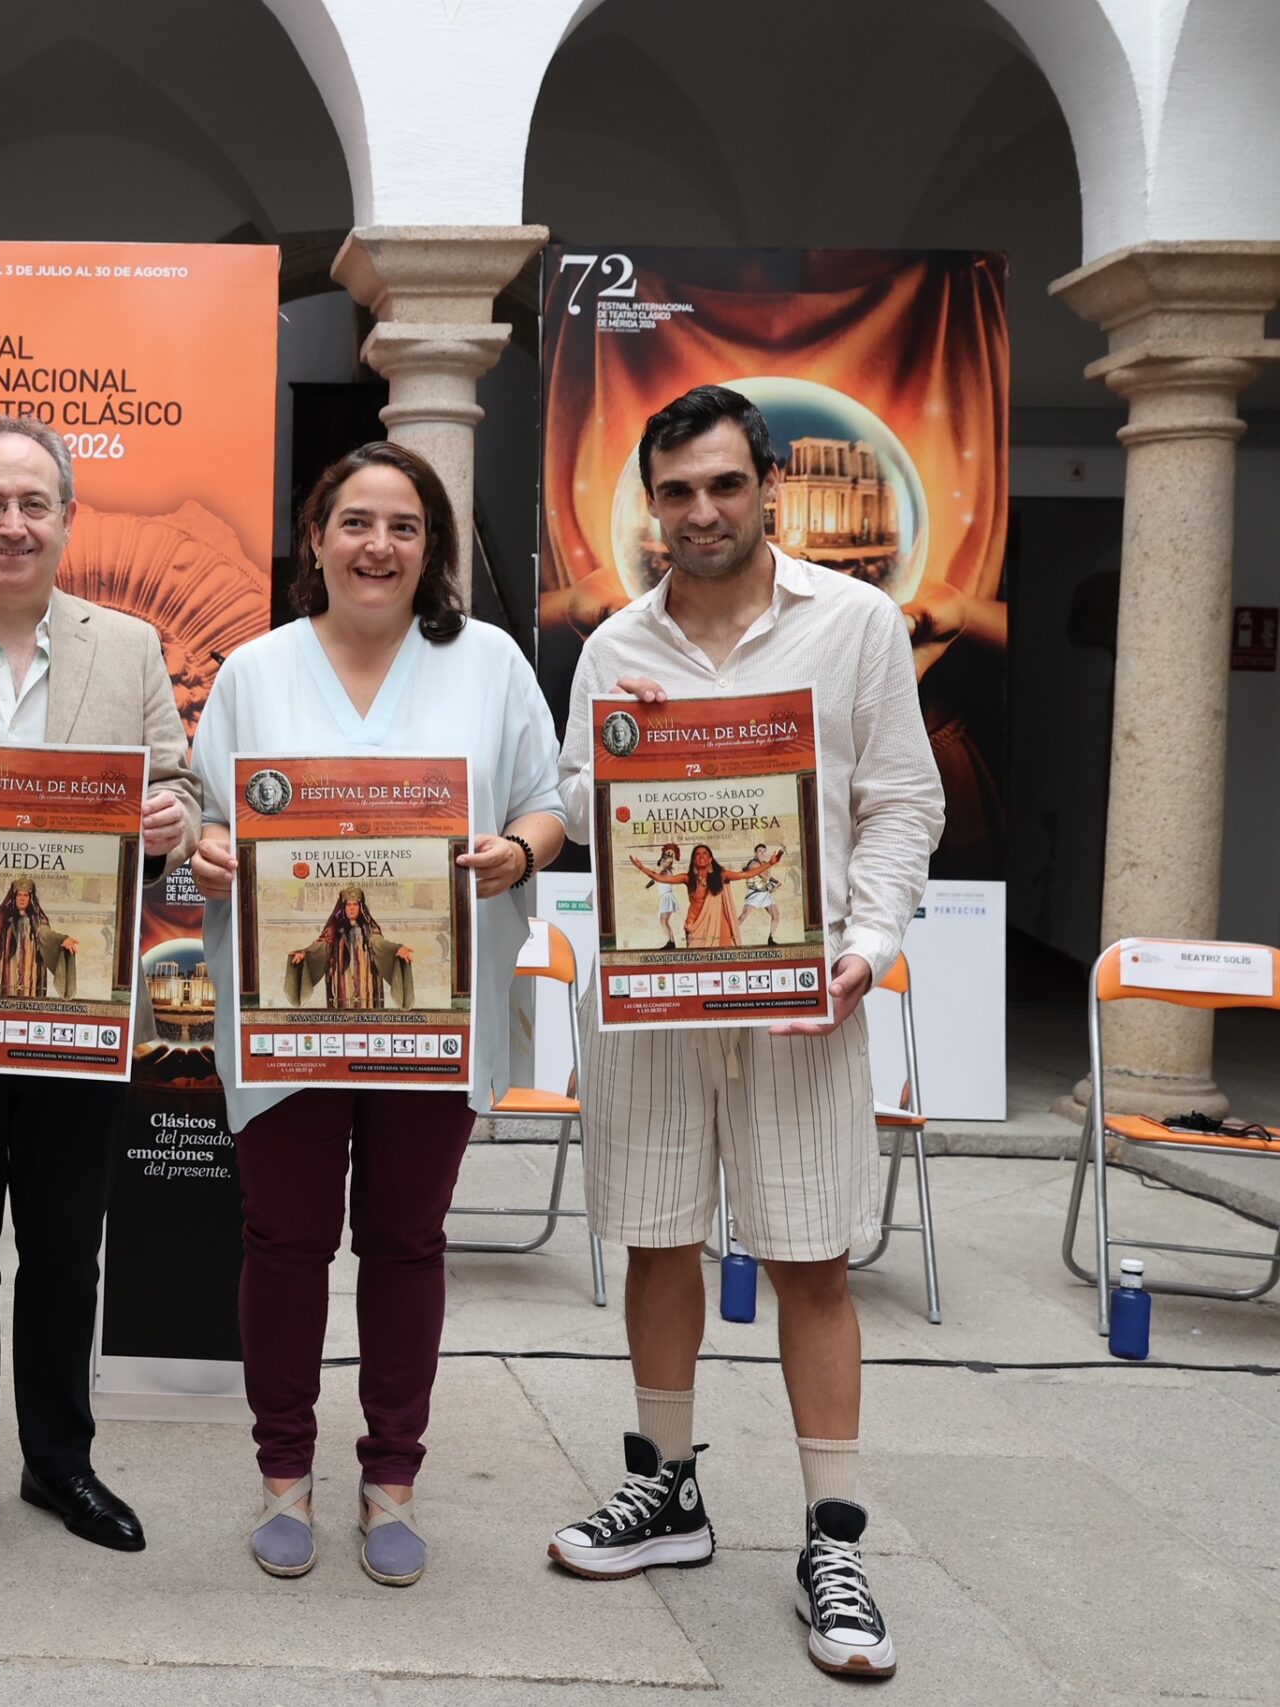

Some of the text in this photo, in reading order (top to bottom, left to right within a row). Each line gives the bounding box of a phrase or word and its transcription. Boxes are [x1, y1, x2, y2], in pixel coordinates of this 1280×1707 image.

[5, 264, 13, 276] 3
[16, 265, 33, 276] DE
[35, 265, 72, 277] JULIO
[74, 265, 90, 277] AL
[95, 266, 110, 277] 30
[114, 266, 131, 278] DE
[133, 266, 189, 278] AGOSTO
[560, 253, 637, 316] 72
[597, 302, 695, 312] FESTIVAL INTERNACIONAL
[597, 310, 671, 321] DE TEATRO CLÁSICO
[597, 319, 656, 329] DE MÉRIDA 2026
[63, 393, 183, 426] CLÁSICO
[63, 432, 125, 460] 2026
[647, 721, 798, 742] FESTIVAL DE REGINA
[685, 764, 701, 777] 72
[48, 781, 66, 793] DE
[71, 781, 126, 795] REGINA
[300, 786, 451, 800] FESTIVAL DE REGINA
[638, 787, 764, 803] 1 DE AGOSTO SÁBADO
[646, 804, 759, 821] ALEJANDRO Y
[16, 815, 30, 827] 72
[632, 815, 781, 835] EL EUNUCO PERSA
[339, 822, 354, 835] 72
[39, 843, 84, 854] VIERNES
[291, 849, 412, 861] 31 DE JULIO VIERNES
[315, 861, 394, 879] MEDEA
[166, 885, 196, 893] DE TEAT
[166, 893, 176, 901] DE
[1181, 953, 1252, 965] BEATRIZ SOLÍS
[150, 1113, 216, 1129] Clásicos
[155, 1129, 234, 1149] del pasado,
[127, 1145, 214, 1161] emociones
[144, 1161, 231, 1180] del presente.
